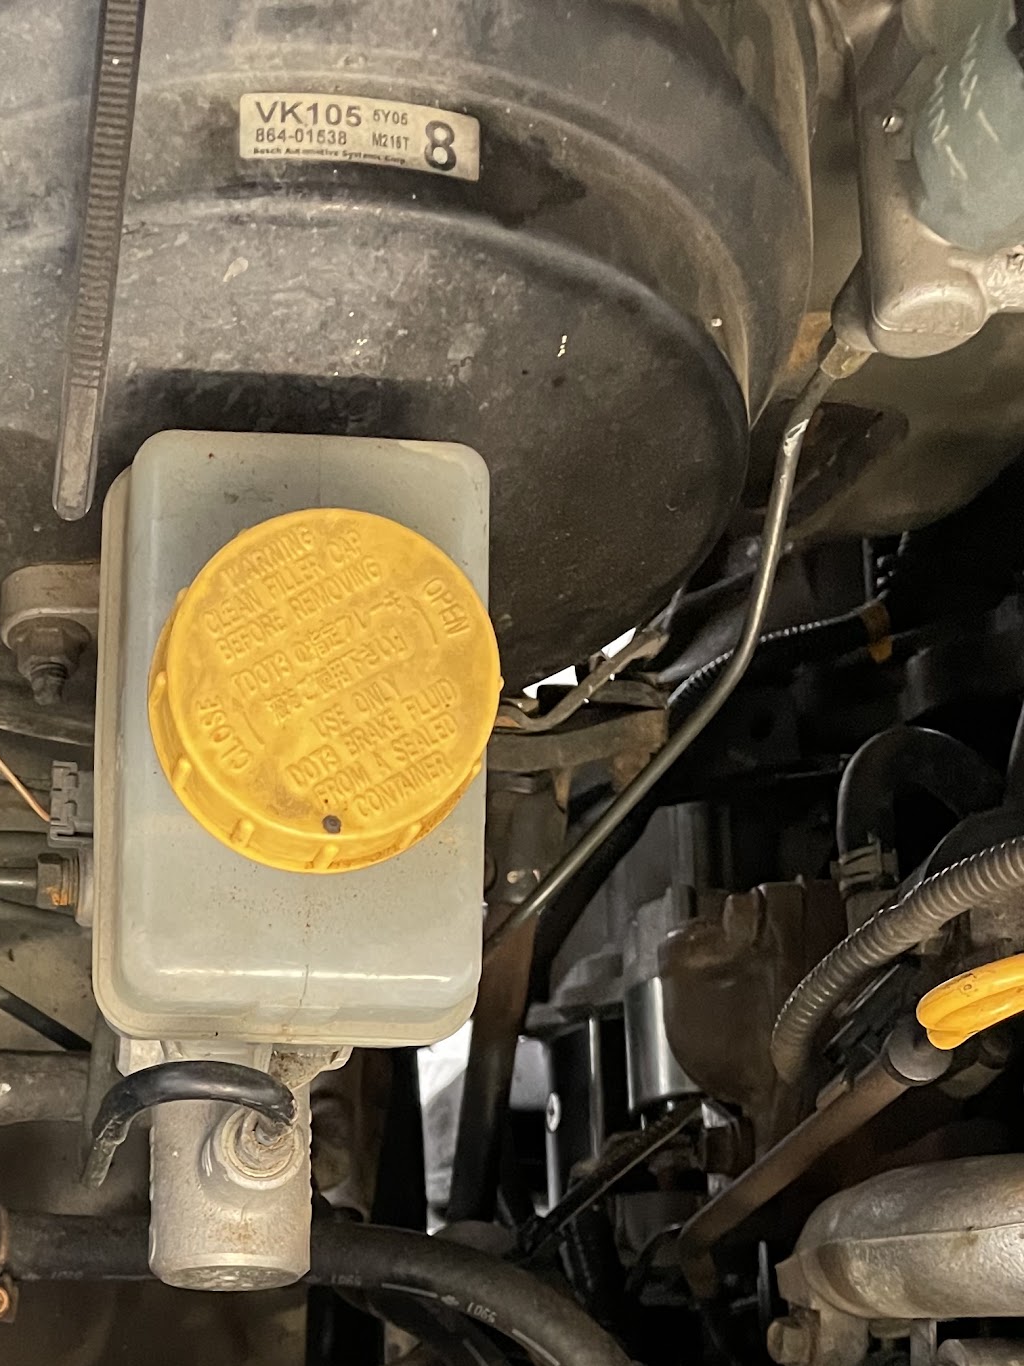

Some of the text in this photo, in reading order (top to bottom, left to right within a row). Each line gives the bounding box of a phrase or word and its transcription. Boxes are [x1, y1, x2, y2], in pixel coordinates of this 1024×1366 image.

[255, 101, 362, 127] VK105
[424, 120, 456, 171] 8
[200, 528, 367, 635] CLEAN FILLER CAP
[221, 522, 317, 593] WARNING
[214, 554, 383, 661] BEFORE REMOVING
[416, 572, 472, 644] OPEN
[193, 688, 255, 777] CLOSE
[285, 675, 460, 789] DOT3 BRAKE FLUID
[310, 672, 404, 740] USE ONLY
[311, 709, 461, 811] FROM A SEALED
[350, 750, 454, 820] CONTAINER
